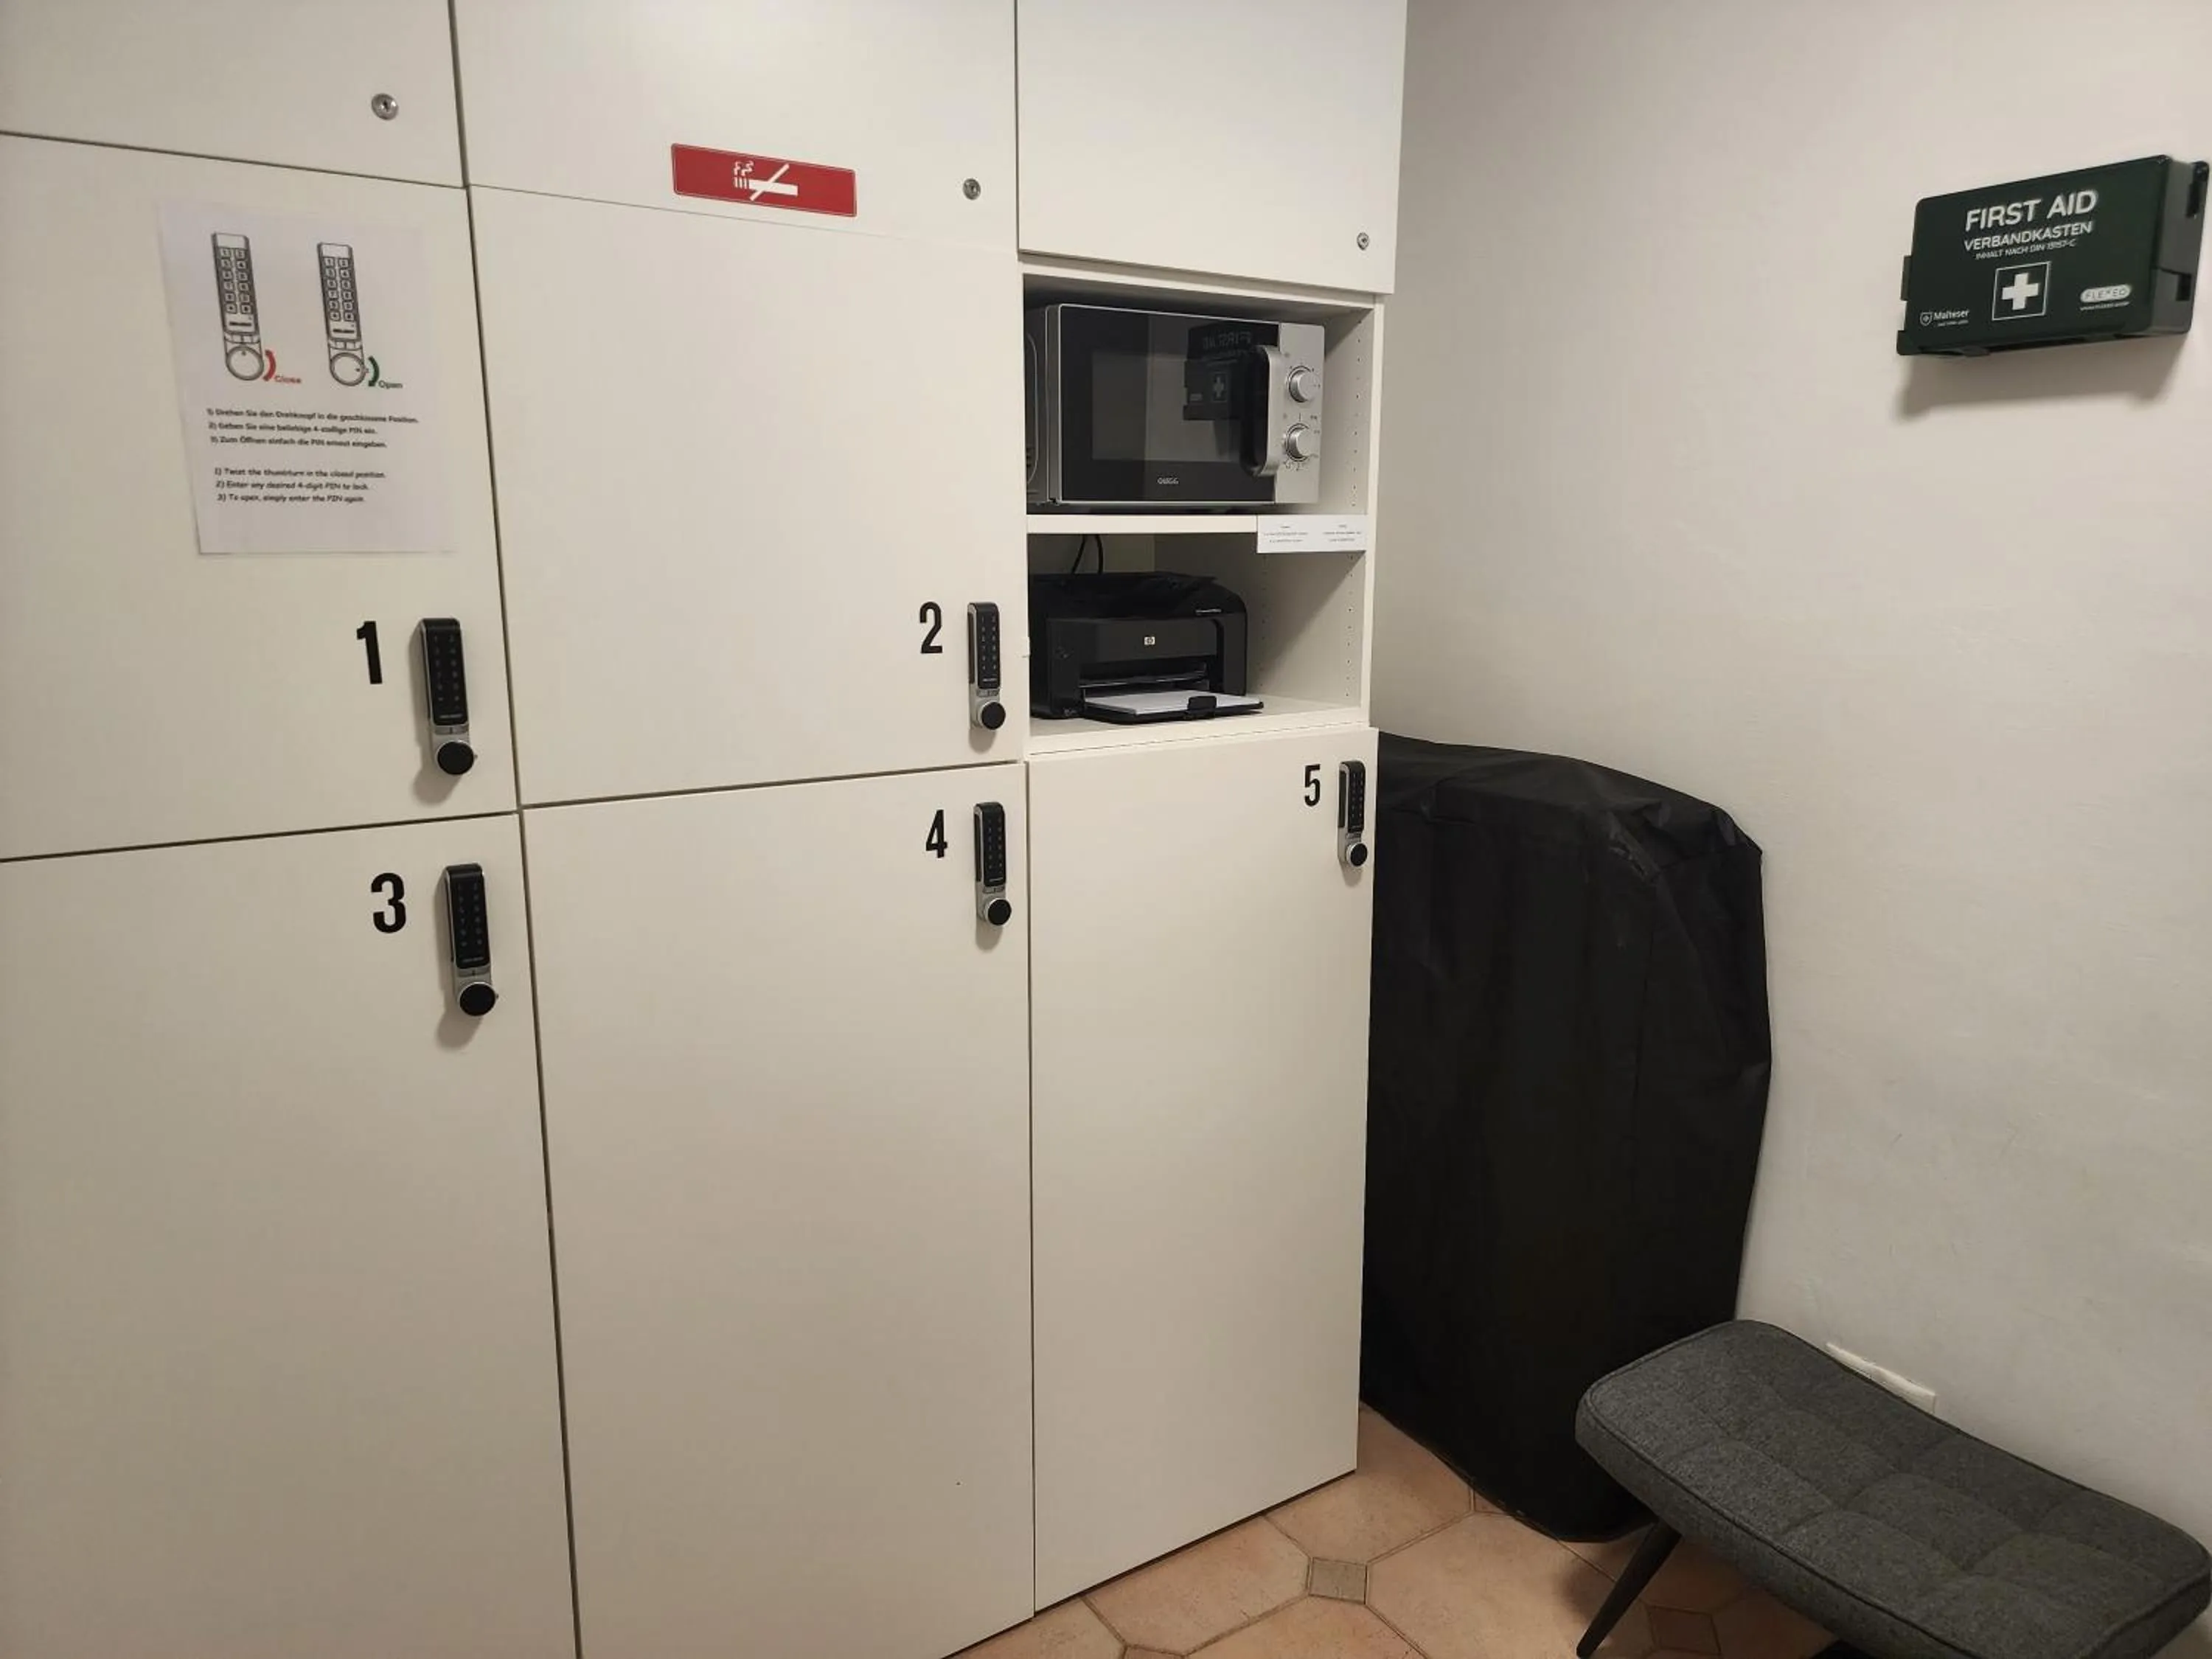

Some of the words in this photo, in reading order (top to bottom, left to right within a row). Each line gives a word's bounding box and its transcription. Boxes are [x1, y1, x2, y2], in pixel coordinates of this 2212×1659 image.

[1965, 198, 2042, 232] FIRST
[2046, 189, 2098, 219] AID
[1964, 220, 2093, 251] VERBANDKASTEN
[2005, 245, 2028, 257] NACH
[378, 380, 403, 389] Open
[919, 602, 942, 653] 2
[356, 621, 383, 684] 1
[1304, 764, 1321, 807] 5
[925, 810, 947, 858] 4
[371, 872, 406, 933] 3
